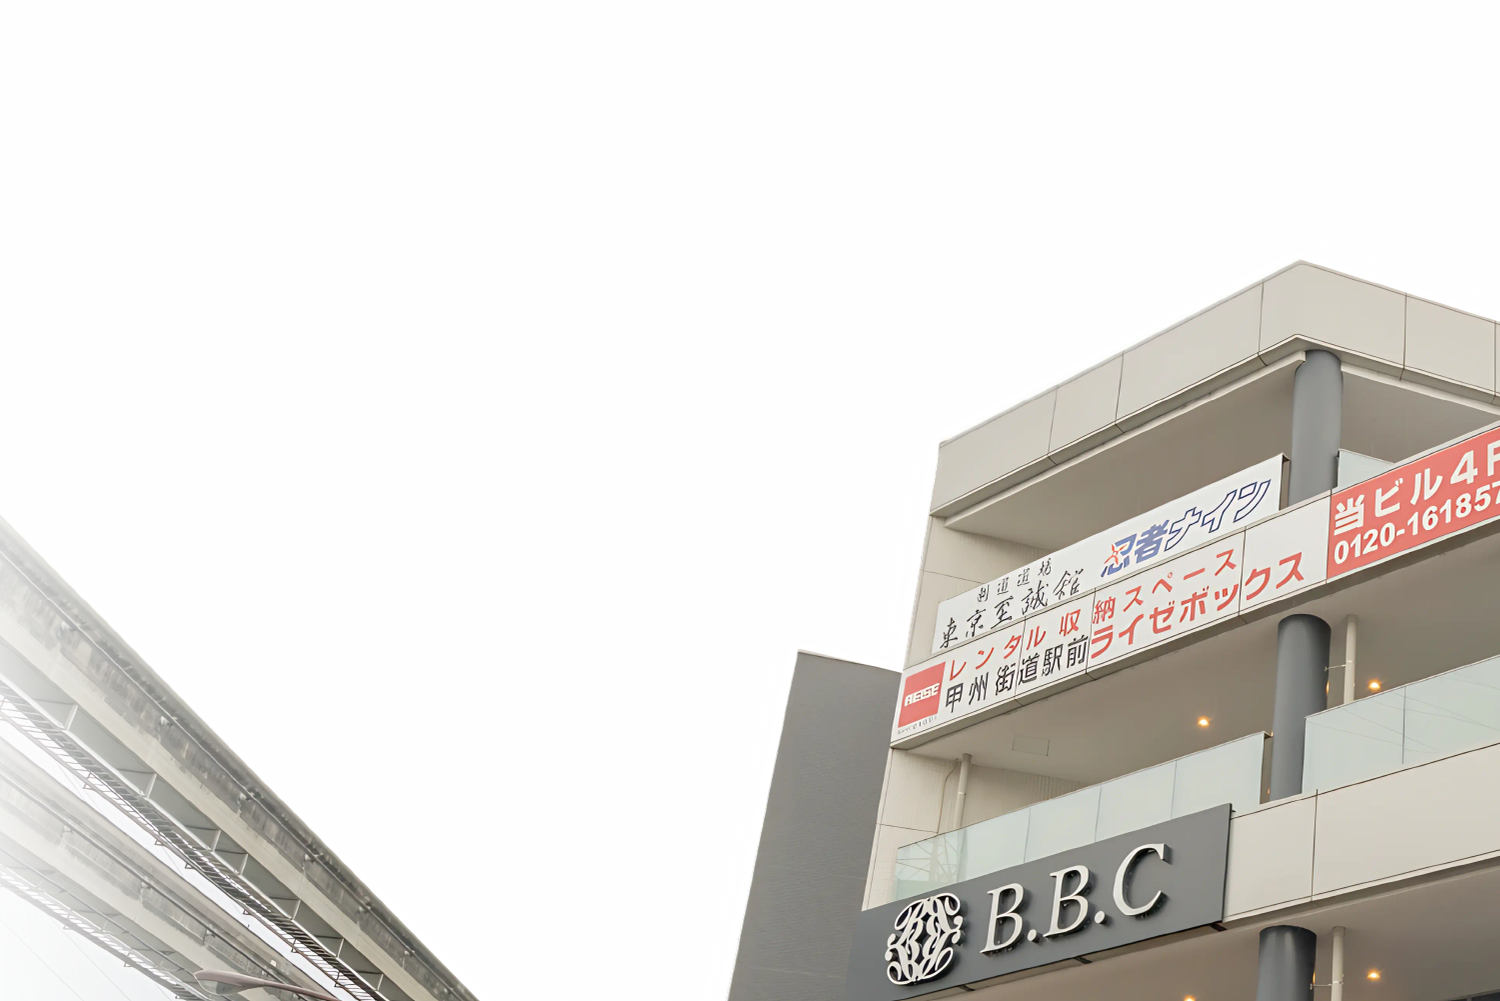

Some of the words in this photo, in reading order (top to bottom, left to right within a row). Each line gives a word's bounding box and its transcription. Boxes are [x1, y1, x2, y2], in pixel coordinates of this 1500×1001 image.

[1100, 479, 1271, 577] 忍者ナイン
[945, 634, 1089, 713] 甲州街道駅前
[1091, 552, 1305, 659] ライゼボックス
[980, 843, 1168, 956] B.B.C
